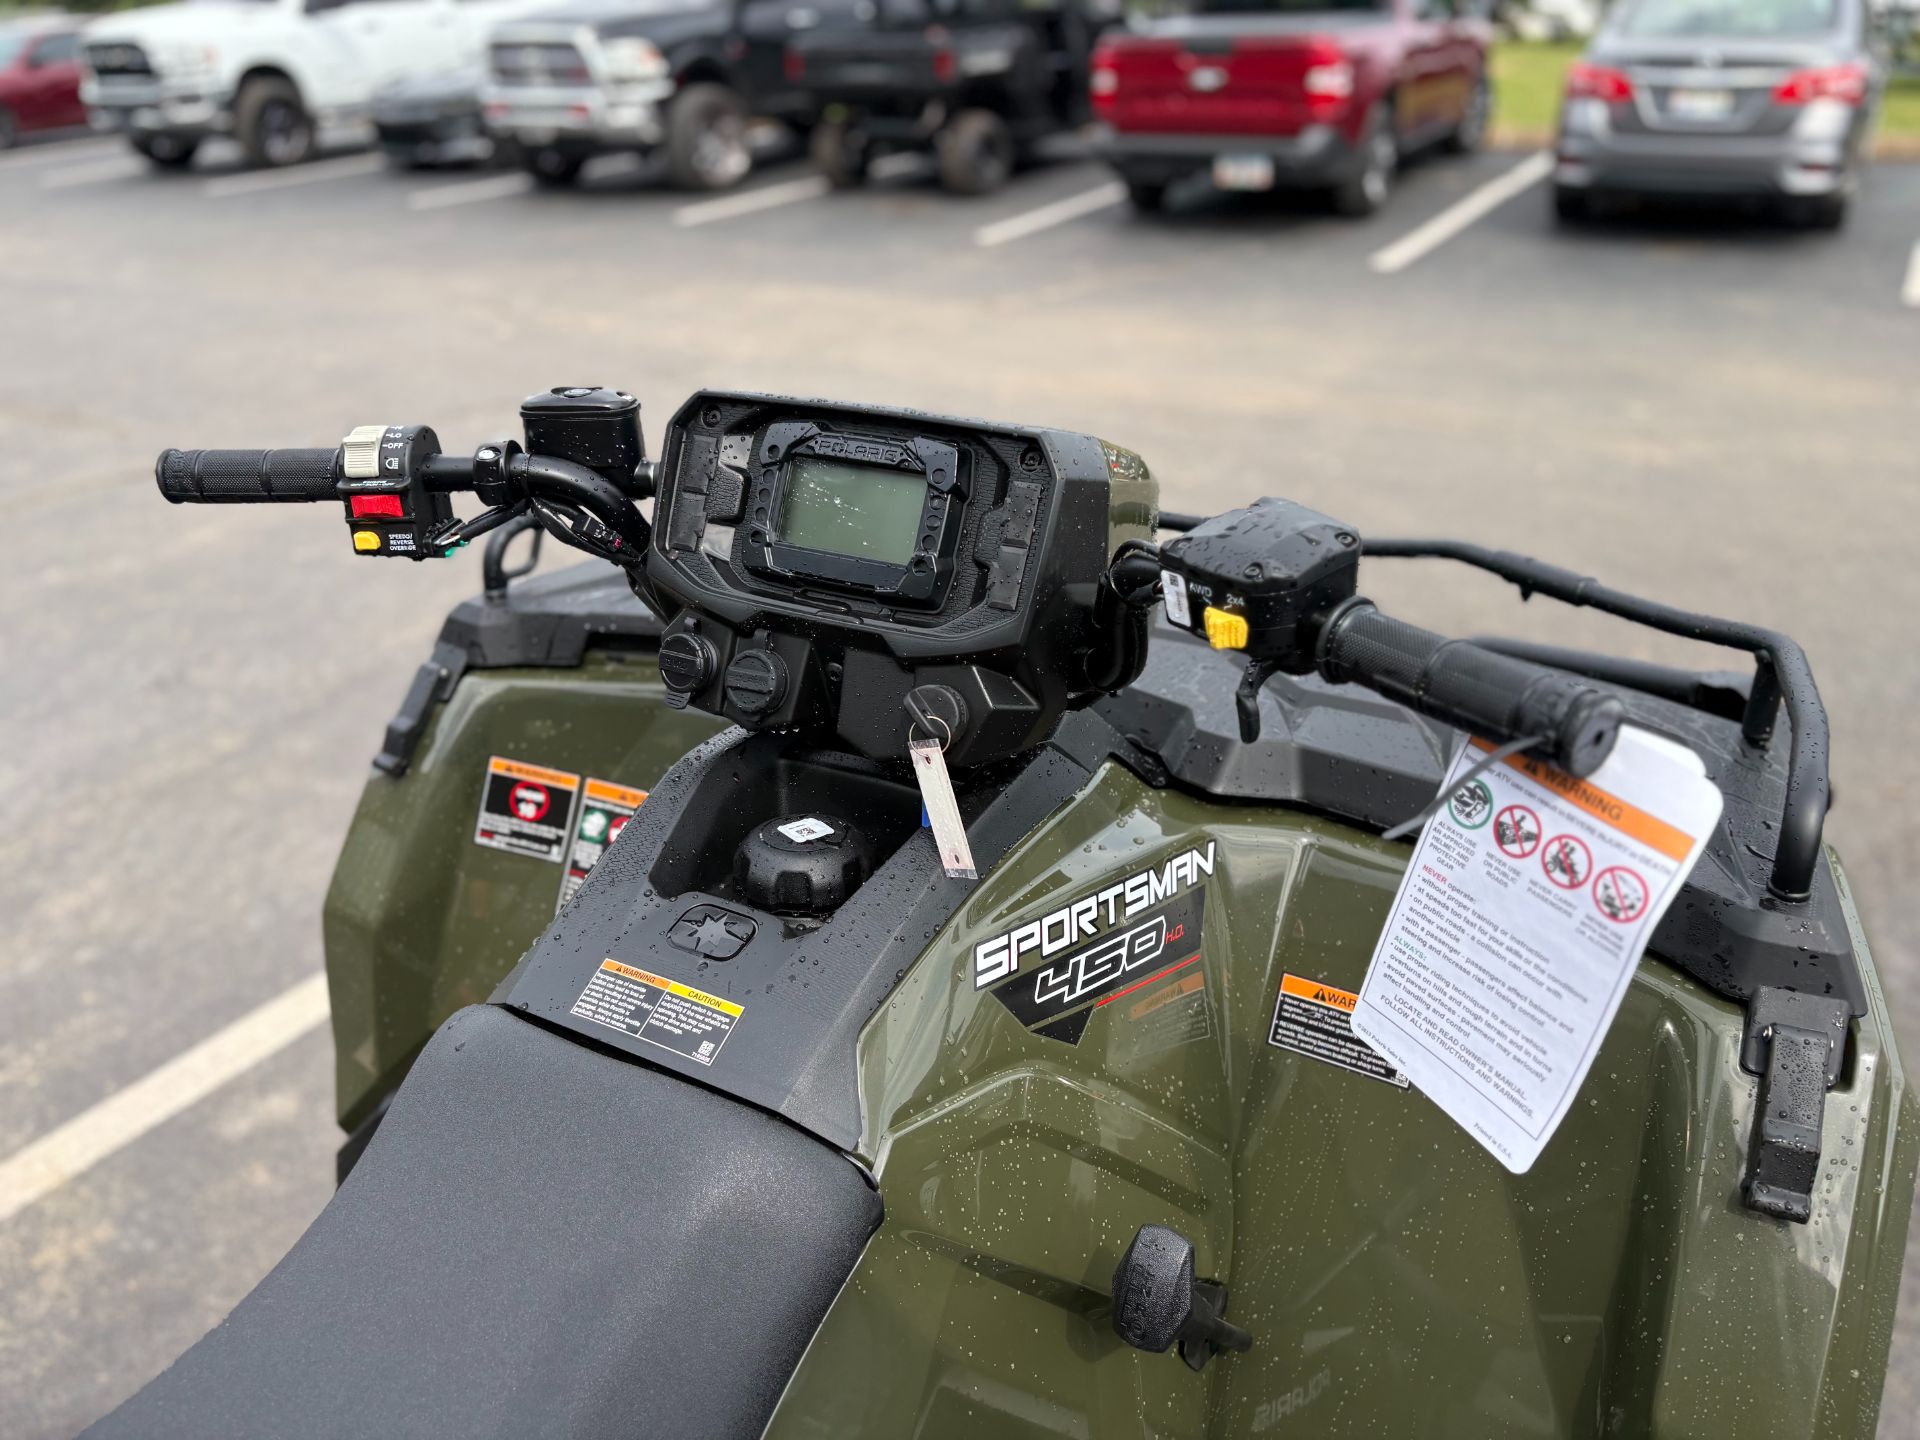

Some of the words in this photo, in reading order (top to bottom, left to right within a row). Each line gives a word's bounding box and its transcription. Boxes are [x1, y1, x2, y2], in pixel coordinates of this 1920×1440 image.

[819, 440, 898, 462] POLARIS
[1189, 582, 1213, 598] AWD
[1422, 863, 1447, 884] NEVER
[975, 840, 1216, 988] SPORTSMAN
[1408, 904, 1435, 926] another
[1435, 922, 1460, 943] vehicle
[1412, 896, 1422, 906] on
[1422, 901, 1445, 921] public
[1444, 916, 1466, 934] roads
[1475, 937, 1507, 962] collision
[1417, 885, 1425, 894] at
[1424, 891, 1450, 911] speeds
[1449, 907, 1462, 919] too
[1462, 915, 1477, 929] fast
[1477, 925, 1489, 936] for
[1420, 875, 1447, 896] without
[1446, 893, 1470, 913] proper
[1470, 908, 1500, 932] training
[1508, 933, 1551, 964] instruction
[621, 967, 656, 983] WARNING
[1034, 915, 1166, 1004] 450
[1393, 944, 1406, 956] use
[1406, 953, 1429, 973] proper
[1429, 969, 1451, 988] riding
[1451, 983, 1490, 1016] techniques
[1400, 923, 1428, 947] steering
[1427, 942, 1441, 956] and
[1442, 952, 1471, 977] increase
[1471, 972, 1486, 987] risk
[1485, 982, 1495, 993] of
[1493, 988, 1517, 1009] losing
[1404, 914, 1420, 928] with
[1425, 929, 1461, 958] passenger
[1464, 956, 1506, 989] passengers
[687, 990, 722, 1007] CAUTION
[1382, 970, 1401, 988] affect
[1401, 984, 1431, 1011] handling
[1431, 1006, 1445, 1020] and
[1445, 1016, 1470, 1039] control
[1386, 962, 1405, 979] avoid
[1405, 975, 1426, 995] paved
[1426, 990, 1456, 1016] surfaces
[1460, 1015, 1495, 1045] pavement
[1494, 1041, 1511, 1057] may
[1389, 952, 1421, 979] overturns
[1421, 976, 1432, 986] on
[1432, 982, 1447, 997] hills
[1447, 993, 1462, 1007] and
[1461, 1003, 1484, 1024] rough
[1393, 993, 1423, 1019] LOCATE
[1422, 1014, 1438, 1031] AND
[1438, 1027, 1459, 1047] READ
[1380, 993, 1409, 1019] FOLLOW
[1409, 1016, 1424, 1031] ALL
[1423, 1027, 1476, 1072] INSTRUCTIONS
[1474, 1067, 1492, 1084] AND
